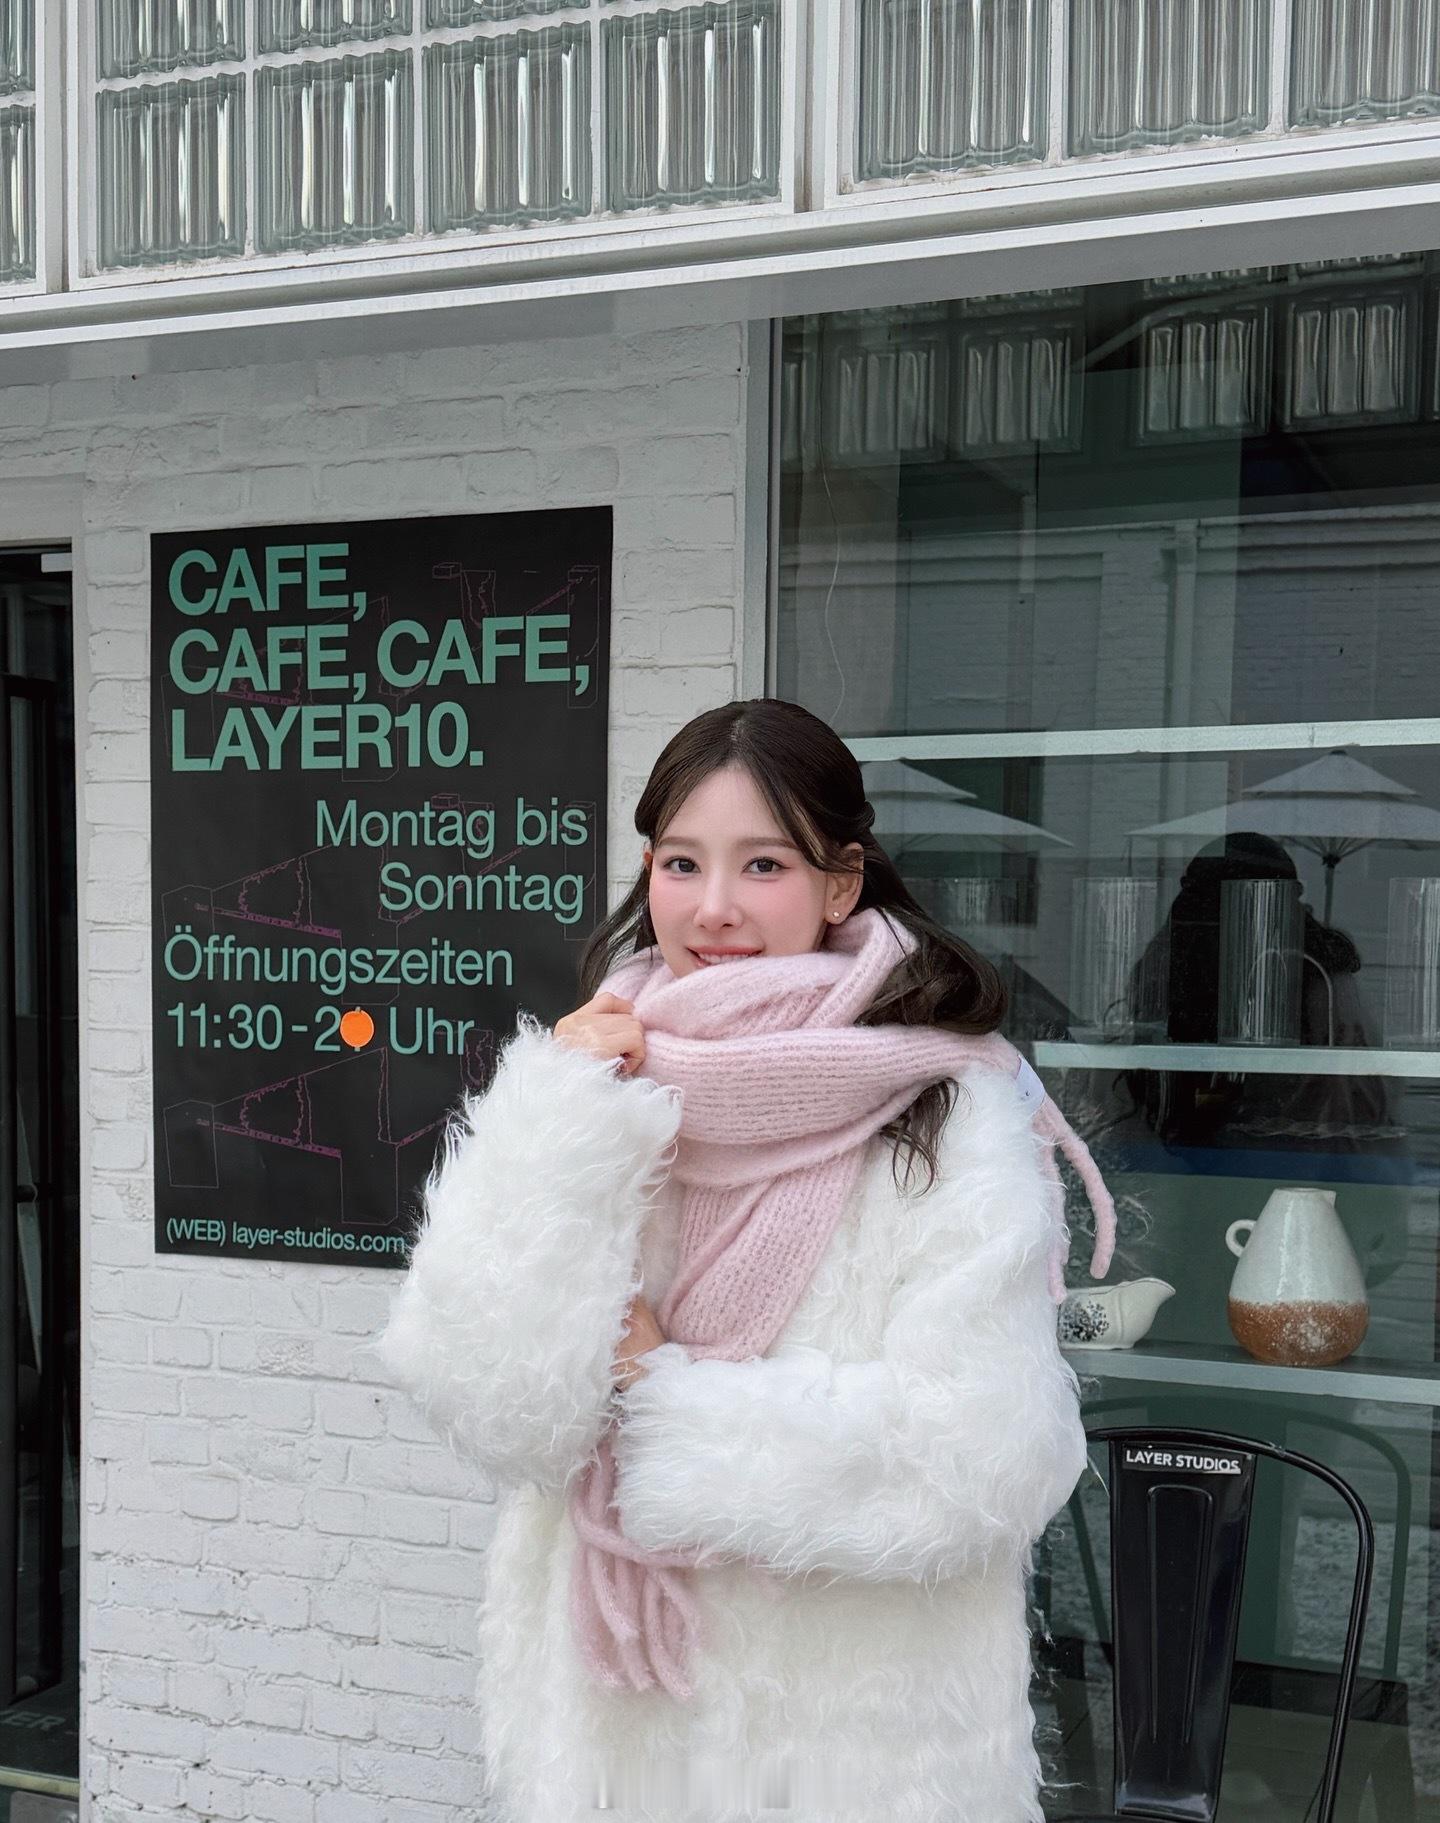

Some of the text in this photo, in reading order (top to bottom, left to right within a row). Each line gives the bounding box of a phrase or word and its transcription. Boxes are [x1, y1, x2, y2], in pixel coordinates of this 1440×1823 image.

[168, 542, 367, 621] CAFE,
[169, 614, 590, 702] CAFE, CAFE,
[171, 701, 484, 772] LAYER10.
[315, 797, 588, 859] Montag bis
[380, 862, 584, 924] Sonntag
[164, 925, 513, 996] Öffnungszeiten
[167, 1002, 475, 1055] 11:30-2 Uhr
[166, 1218, 406, 1253] (WEB) layer-studios.com
[1126, 1450, 1239, 1472] LAYER STUDIOS
